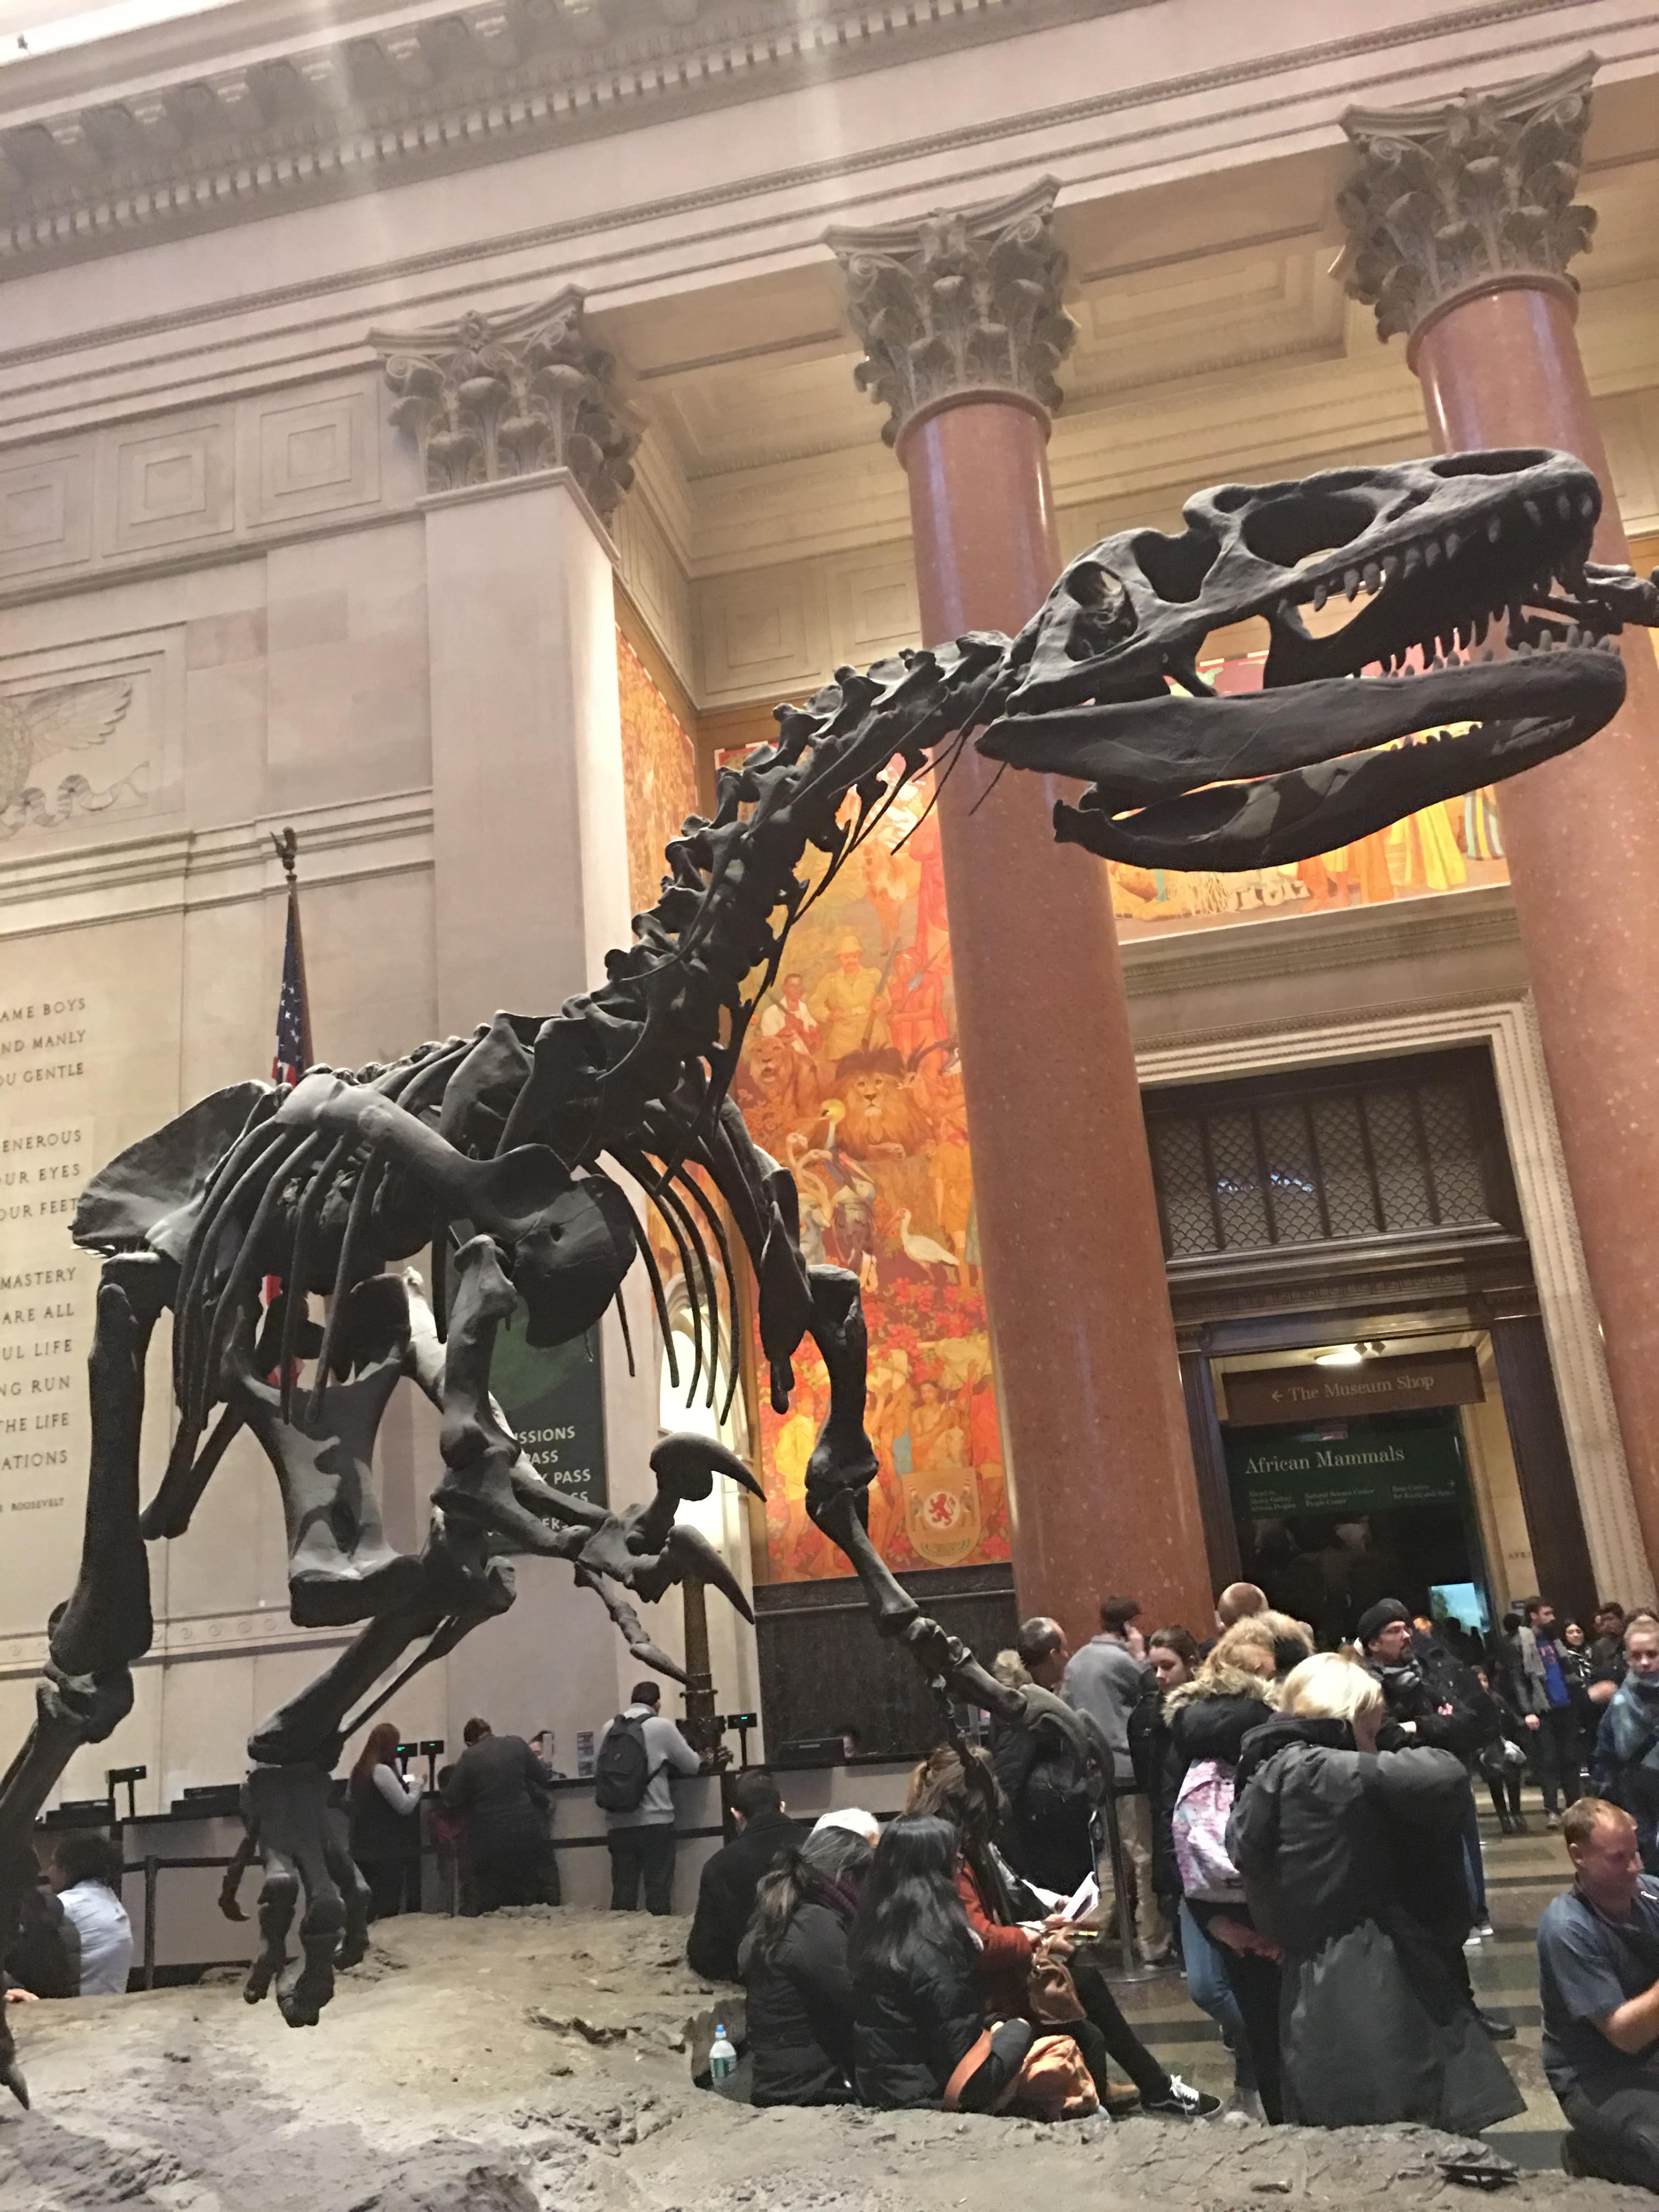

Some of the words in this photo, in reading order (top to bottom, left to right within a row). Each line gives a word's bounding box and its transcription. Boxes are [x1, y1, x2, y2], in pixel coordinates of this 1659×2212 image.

[43, 998, 85, 1015] BOYS
[32, 1029, 86, 1049] MANLY
[23, 1062, 84, 1083] GENTLE
[3, 1130, 81, 1153] ENEROUS
[0, 1171, 30, 1186] UR
[39, 1164, 80, 1181] EYES
[40, 1197, 78, 1215] FEET
[0, 1267, 76, 1289] MASTERY
[2, 1308, 36, 1324] ARE
[43, 1303, 75, 1319] ALL
[35, 1339, 72, 1356] LIFE
[31, 1375, 70, 1393] RUN
[1289, 1386, 1319, 1401] The
[1325, 1379, 1392, 1398] Museum
[1397, 1375, 1435, 1390] Shop
[35, 1412, 69, 1429] LIFE
[2, 1449, 67, 1470] ATIONS
[1245, 1455, 1311, 1474] African
[1316, 1445, 1405, 1468] Mammals
[554, 1468, 591, 1485] PASS
[11, 1497, 65, 1511] ROOSEVELT
